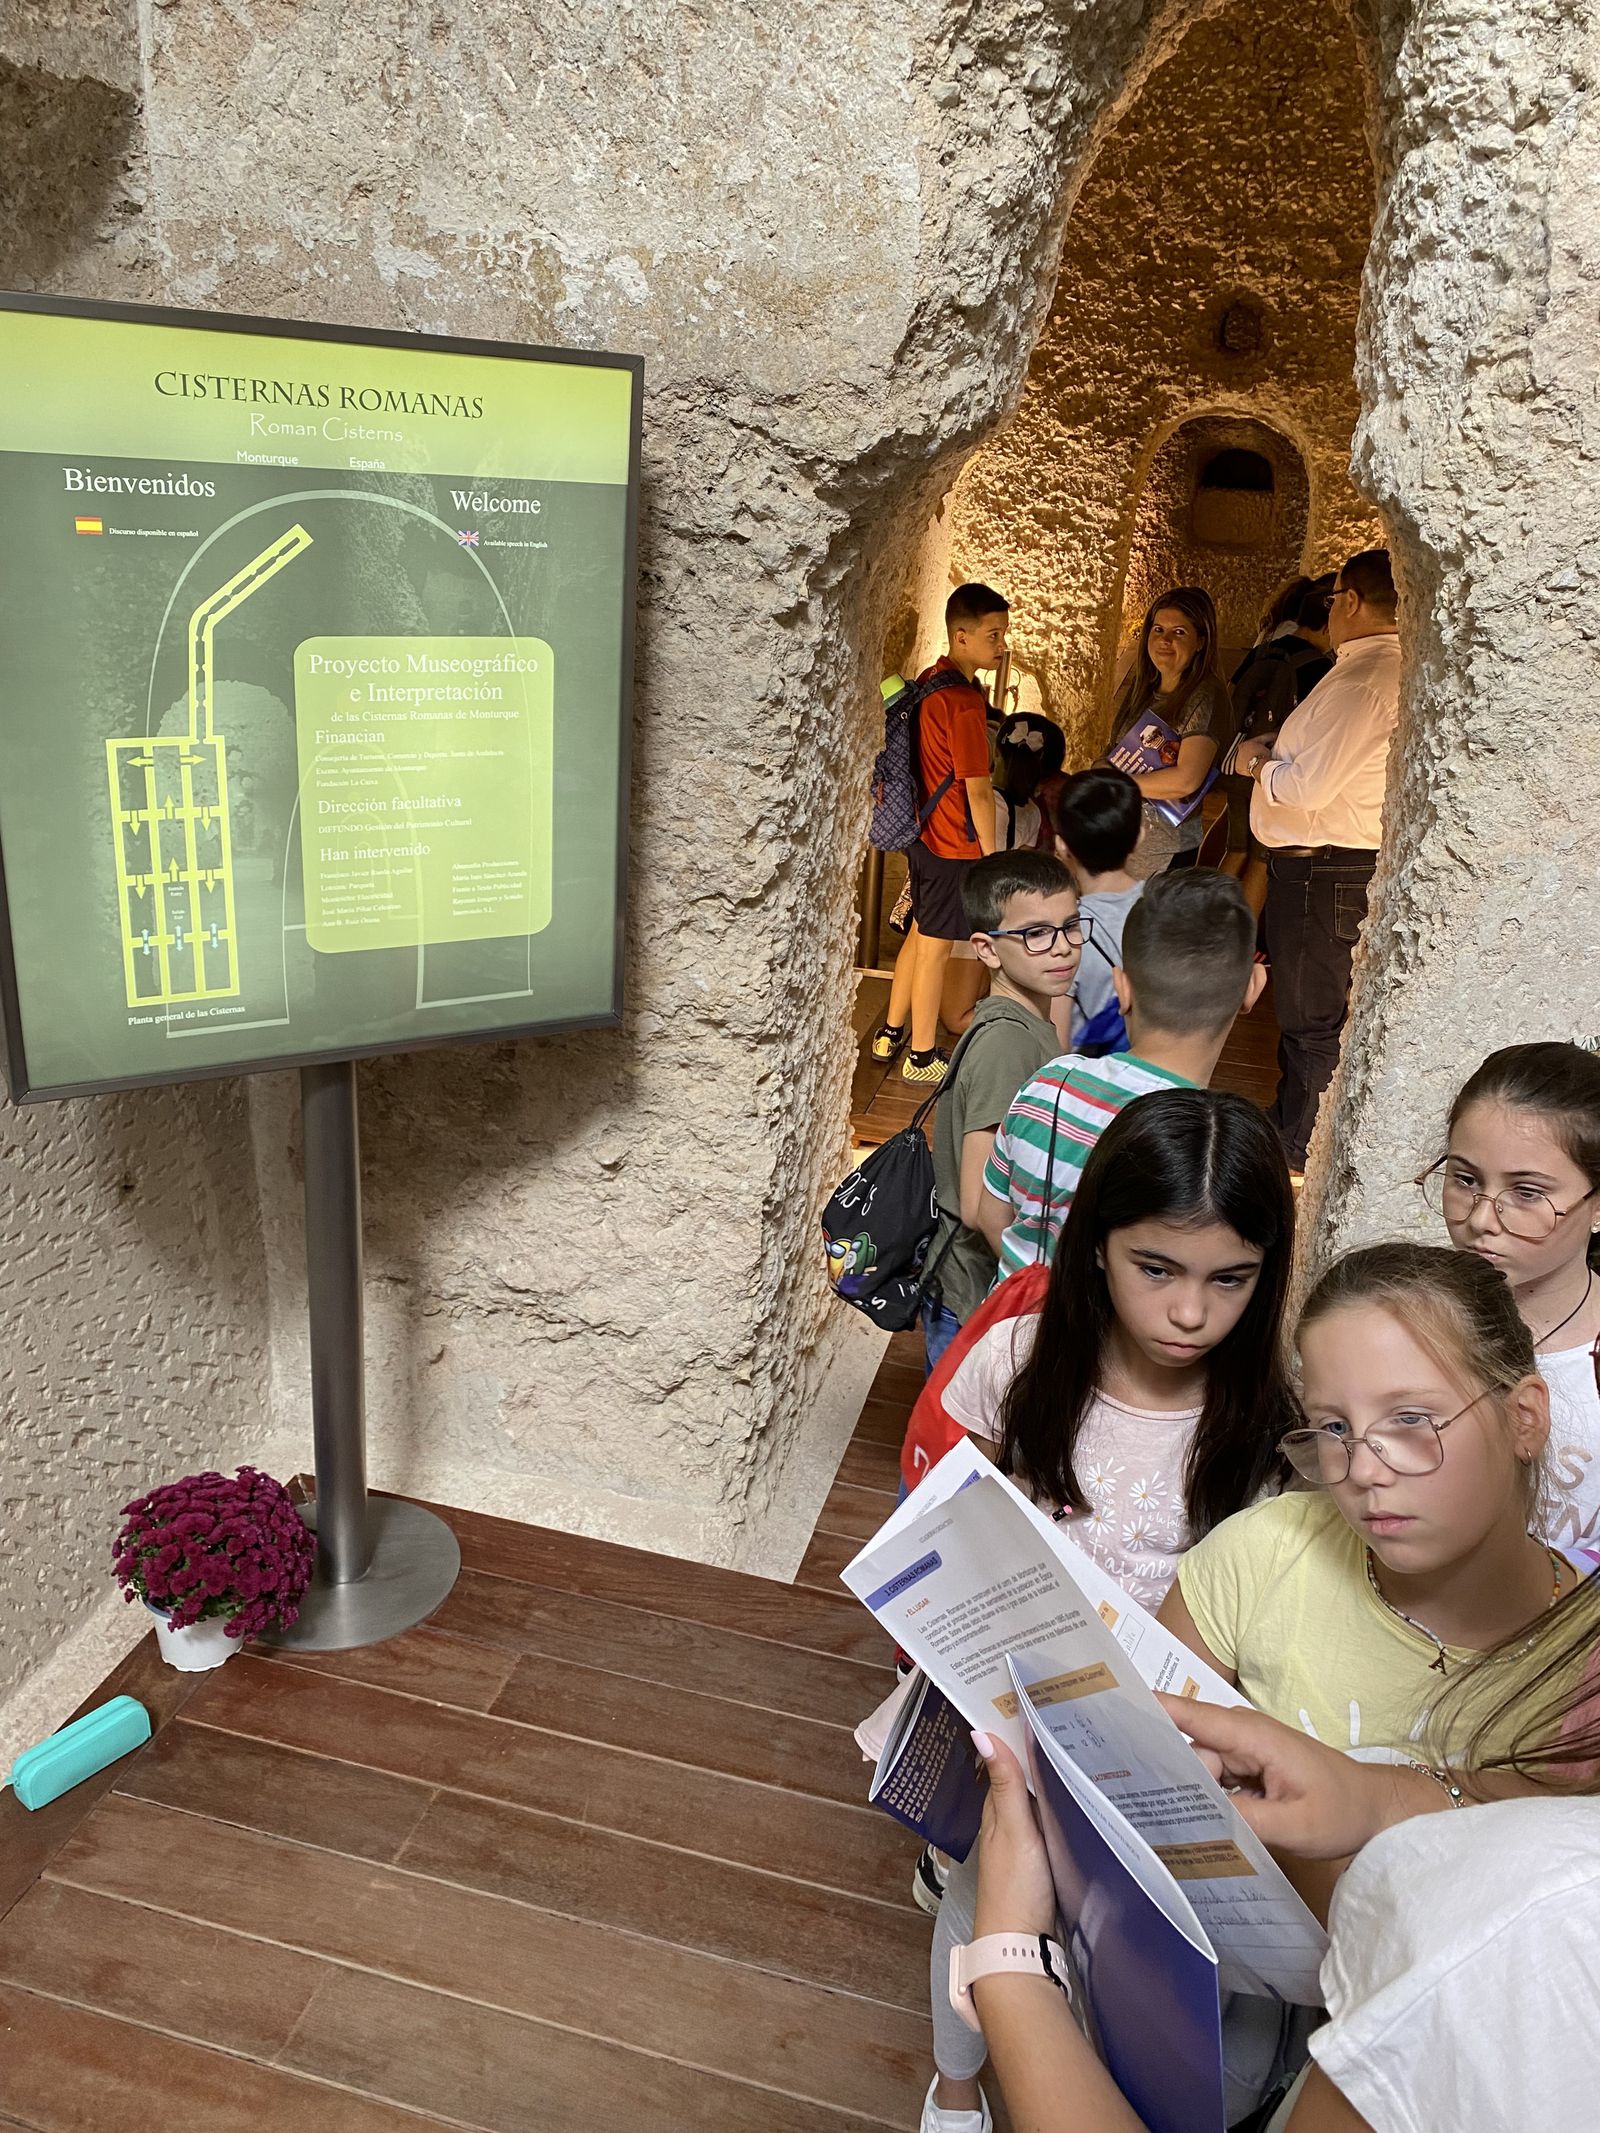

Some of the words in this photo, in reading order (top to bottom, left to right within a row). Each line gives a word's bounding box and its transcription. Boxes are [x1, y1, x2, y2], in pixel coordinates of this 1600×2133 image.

[154, 371, 330, 409] CISTERNAS
[339, 386, 484, 420] ROMANAS
[250, 412, 317, 437] Roman
[322, 416, 403, 442] Cisterns
[236, 450, 299, 467] Monturque
[349, 456, 386, 472] España
[62, 467, 216, 497] Bienvenidos
[449, 490, 541, 514] Welcome
[109, 527, 136, 535] Discurso
[136, 528, 167, 537] disponible
[176, 530, 199, 538] español
[309, 654, 400, 678] Proyecto
[406, 653, 538, 678] Museográfico
[350, 688, 361, 702] e
[367, 682, 504, 706] Interpretación
[330, 711, 343, 722] de
[345, 711, 360, 722] las
[362, 711, 408, 722] Cisternas
[409, 710, 454, 721] Romanas
[455, 709, 467, 720] de
[469, 709, 520, 721] Monturque
[314, 728, 385, 744] Financian
[318, 797, 388, 814] Dirección
[391, 794, 462, 811] facultativa
[320, 848, 349, 862] Han
[353, 841, 432, 860] intervenido
[128, 1016, 154, 1026] Planta
[154, 1011, 184, 1024] general
[185, 1010, 196, 1019] de
[196, 1008, 209, 1018] las
[209, 1005, 246, 1016] Cisternas
[882, 1715, 927, 1799] Cuaderno
